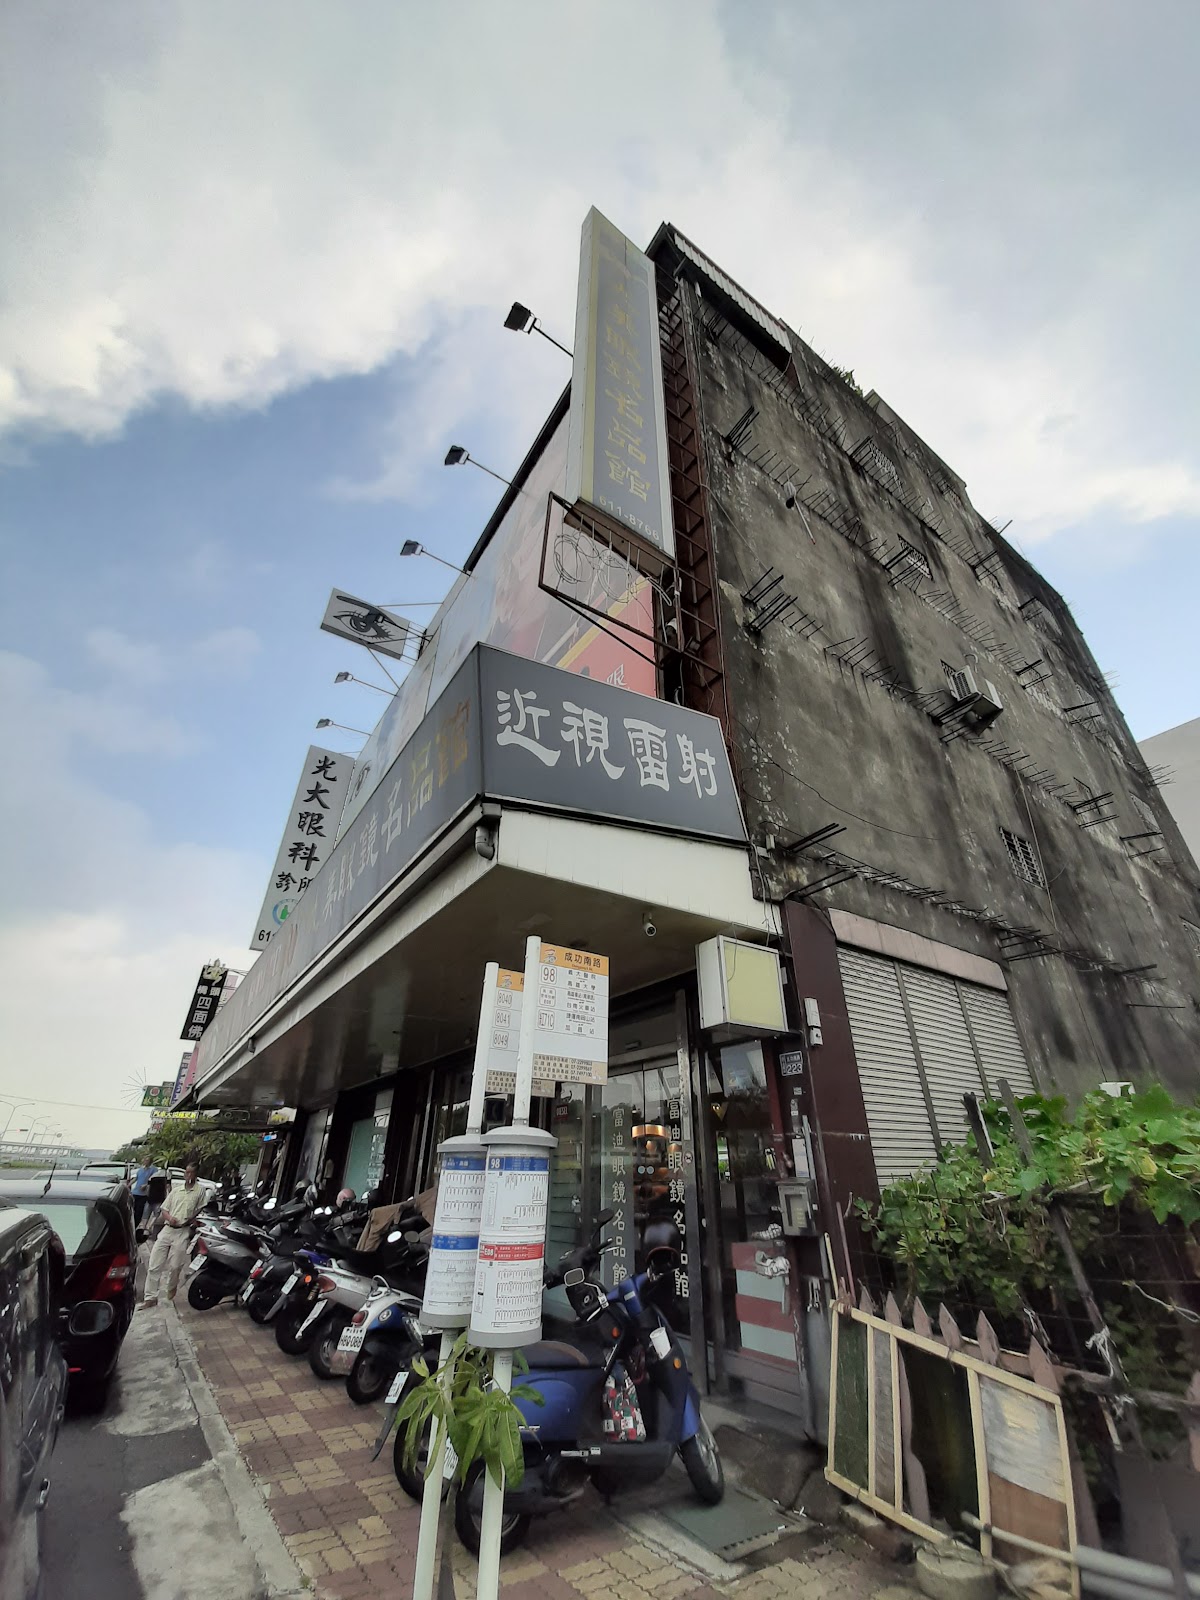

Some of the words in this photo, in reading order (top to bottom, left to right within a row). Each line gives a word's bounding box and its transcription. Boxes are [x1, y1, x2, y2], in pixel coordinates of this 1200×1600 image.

[599, 495, 660, 541] 611-8766
[496, 688, 718, 799] 近視雷射
[288, 755, 337, 872] 光大眼科
[543, 967, 555, 982] 98
[565, 952, 601, 968] 成功南路
[188, 996, 212, 1038] 四面佛
[787, 1063, 802, 1073] 223
[490, 1158, 501, 1168] 98
[612, 1107, 627, 1285] 富迪眼鏡名品館
